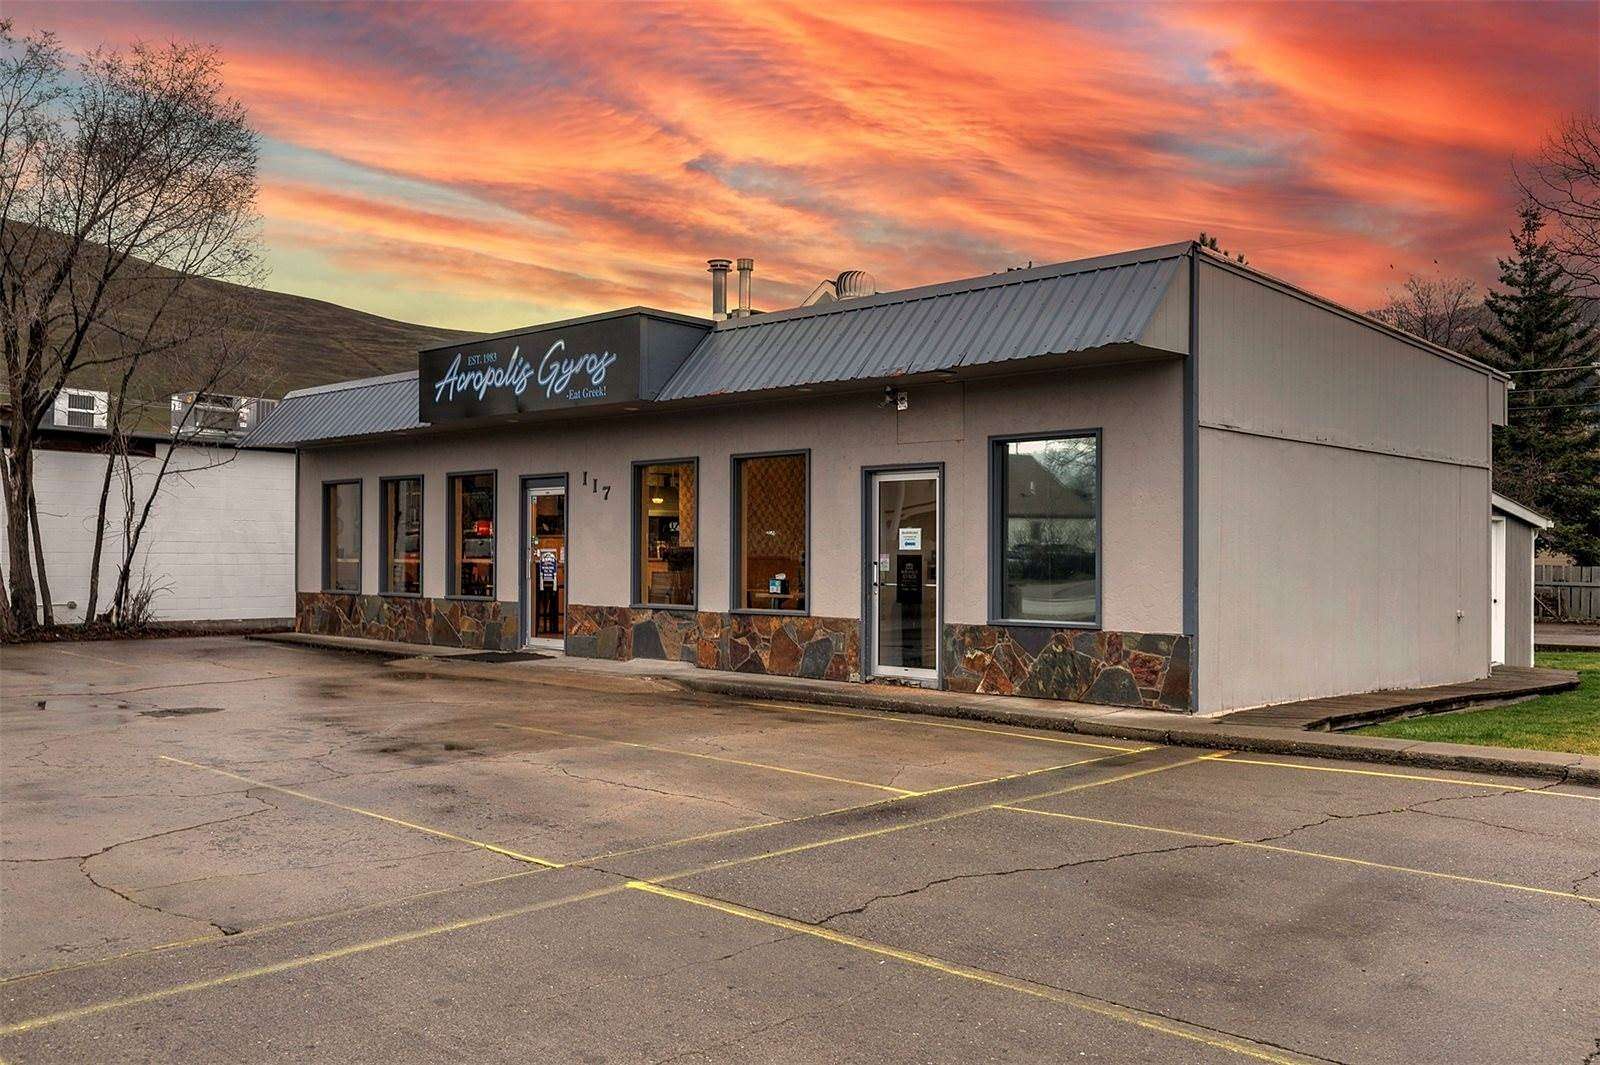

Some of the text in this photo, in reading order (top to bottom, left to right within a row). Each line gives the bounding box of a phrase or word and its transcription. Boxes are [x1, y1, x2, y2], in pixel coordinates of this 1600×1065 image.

[467, 354, 482, 366] EST.
[435, 339, 617, 402] Acropolis Gyros
[582, 386, 607, 398] Greek!
[582, 471, 611, 500] 117
